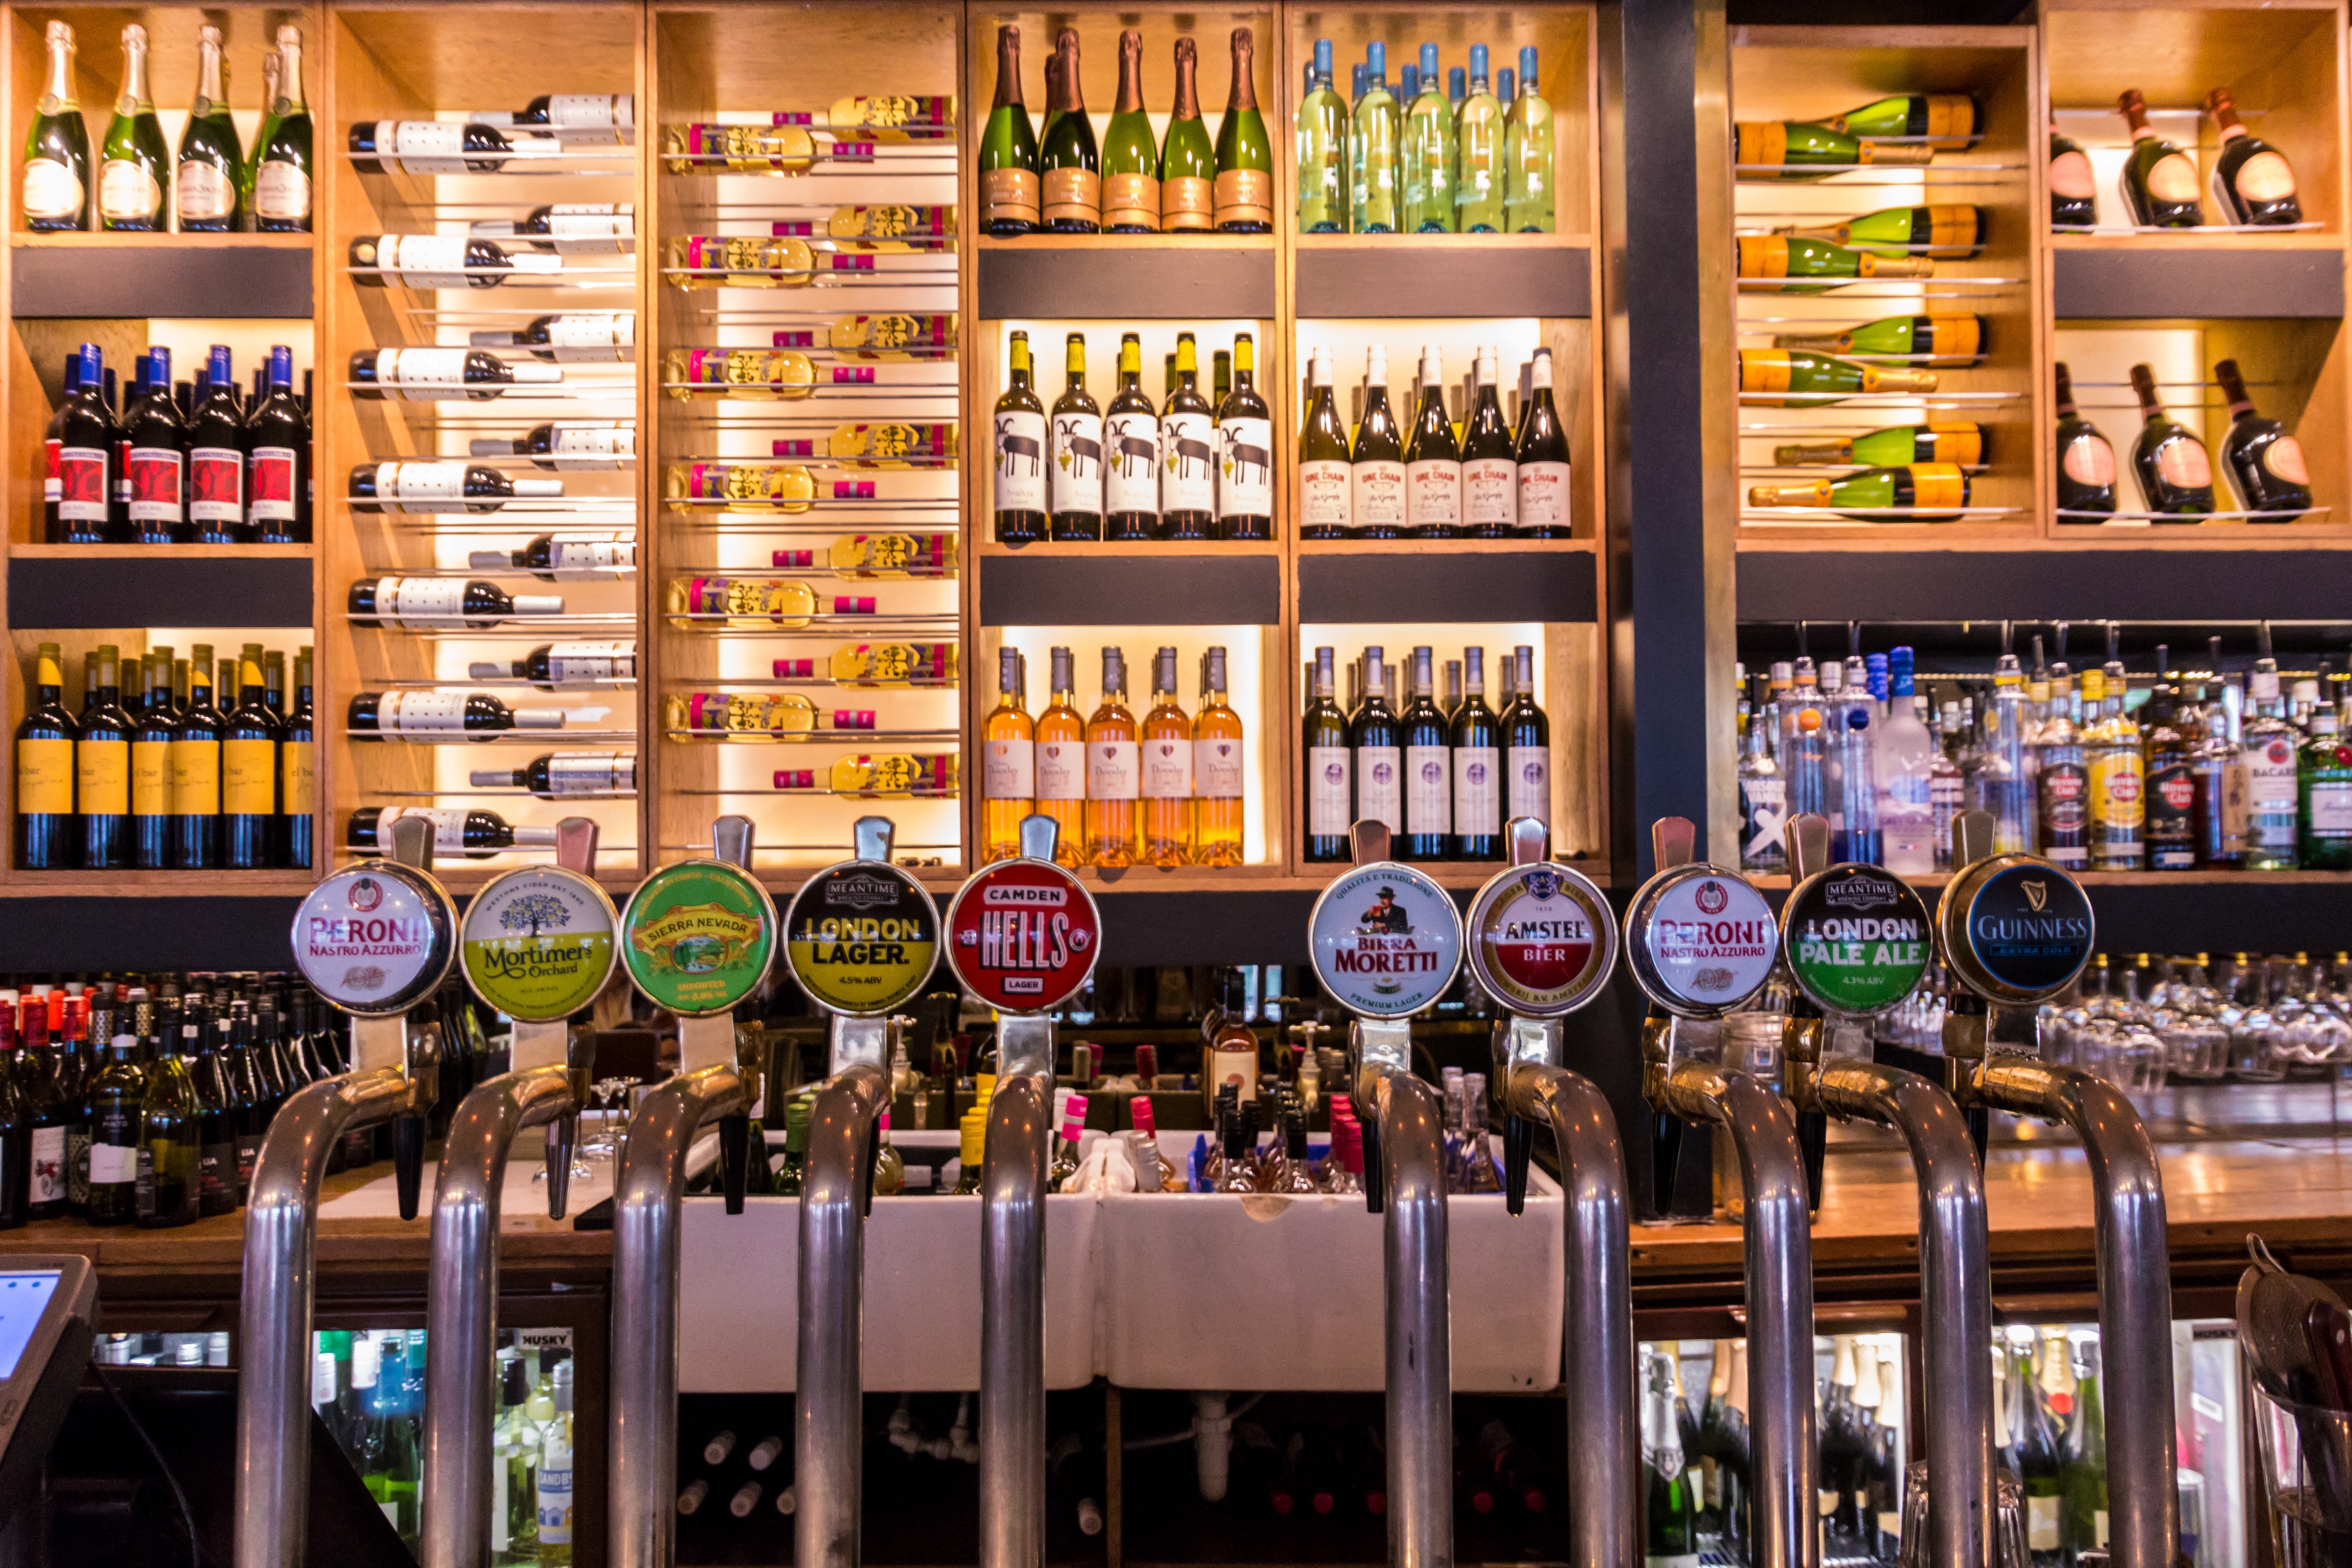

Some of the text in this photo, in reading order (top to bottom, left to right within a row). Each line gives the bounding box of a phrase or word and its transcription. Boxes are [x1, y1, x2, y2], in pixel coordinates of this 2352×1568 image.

[1322, 471, 1344, 482] CHAIN
[1380, 472, 1401, 483] CHAIN
[1433, 471, 1455, 482] CHAIN
[830, 883, 895, 894] MEANTIME
[1382, 873, 1433, 897] TRADIZIONE
[1830, 885, 1892, 895] MEANTIME
[989, 889, 1060, 901] CAMDEN
[310, 917, 419, 943] PERONI
[648, 918, 749, 942] SIERRA NEVADA
[806, 917, 919, 940] LONDON
[1505, 920, 1583, 939] AMSTEL
[1660, 919, 1763, 944] PERONI
[1808, 918, 1917, 941] LONDON
[1978, 915, 2087, 941] GUINNESS
[981, 911, 1069, 970] HELLS
[1358, 937, 1417, 951] BIRRA
[310, 944, 422, 956] NASTRO AZZURRO
[1523, 948, 1566, 961] BIER
[1661, 946, 1766, 958] NASTRO AZZURRO
[1799, 943, 1865, 965] PALE
[2001, 946, 2040, 954] EXTRA
[1335, 948, 1438, 973] MORETTI
[529, 962, 578, 977] Orchard
[677, 980, 725, 990] IMPORTED
[1843, 976, 1885, 985] 4.3% ABV
[1350, 992, 1423, 1008] PREMIUM LAGER
